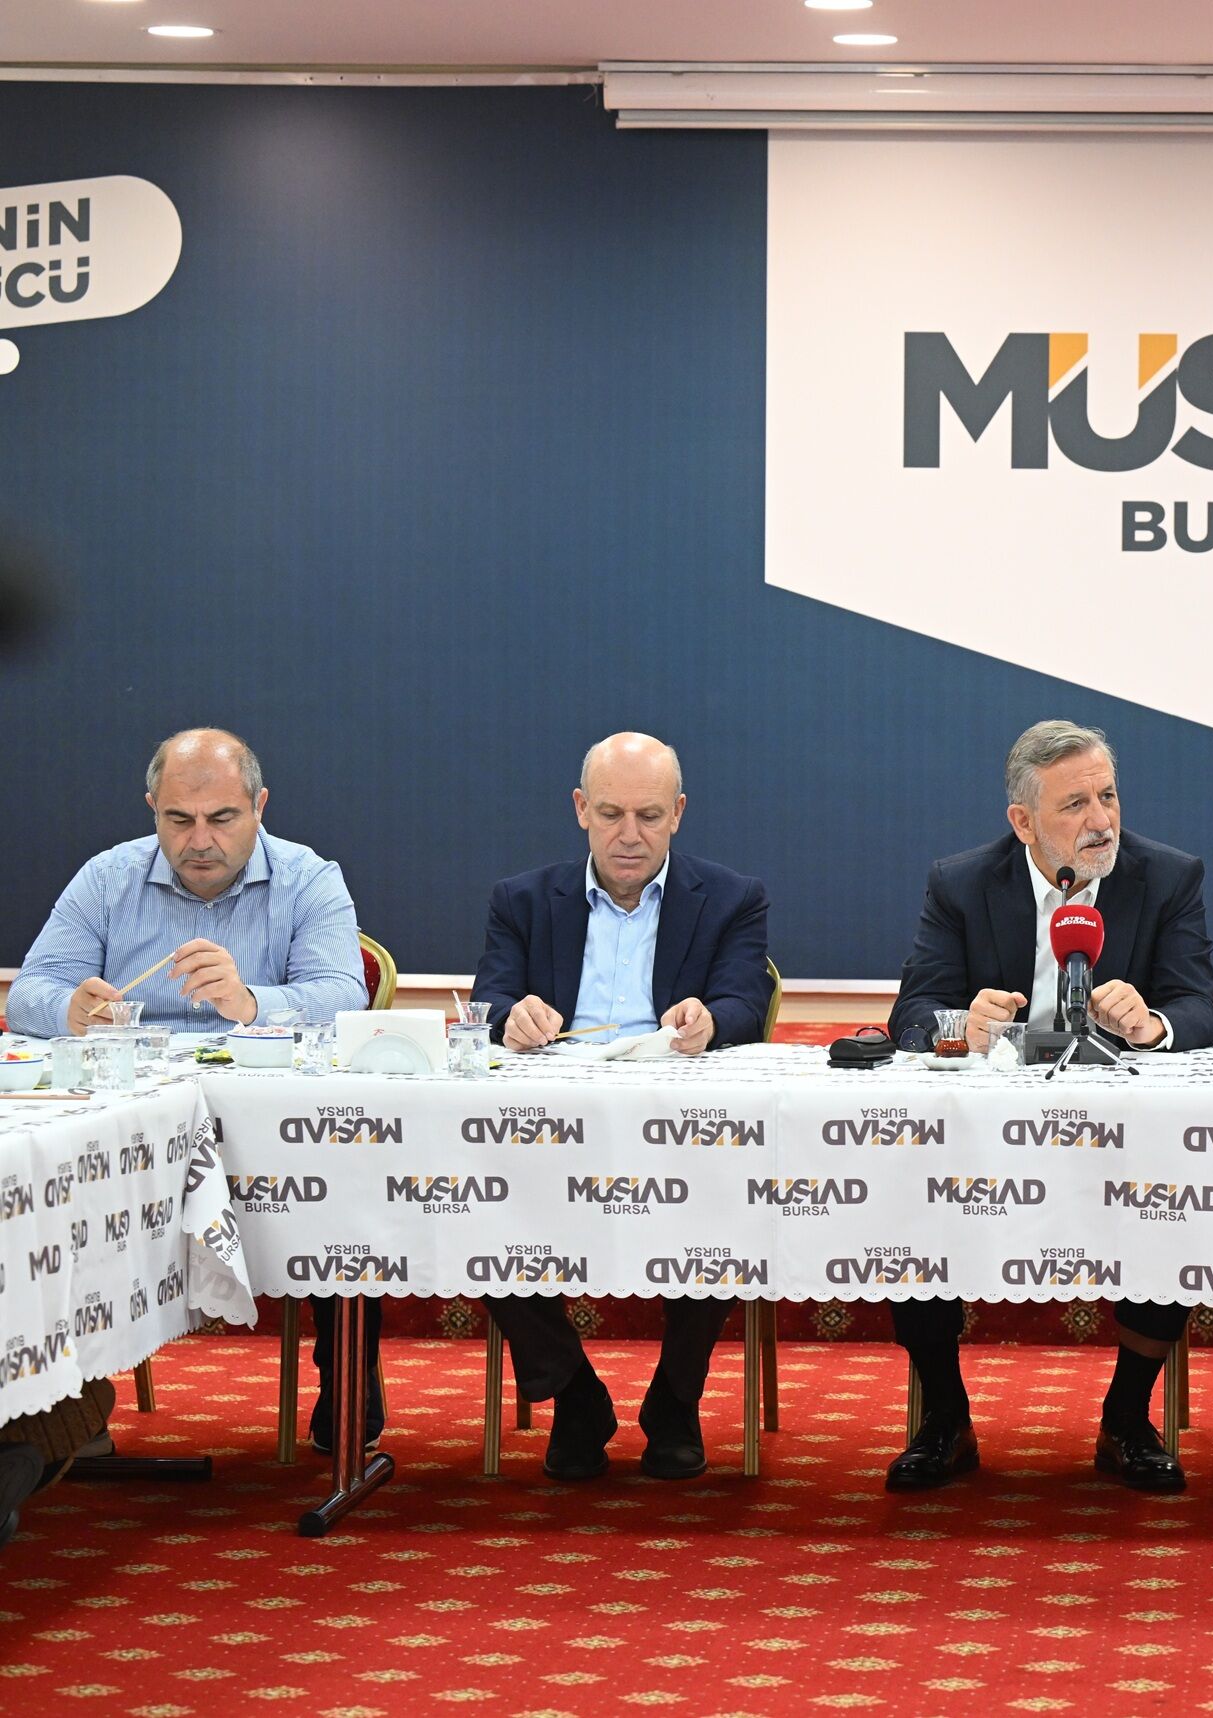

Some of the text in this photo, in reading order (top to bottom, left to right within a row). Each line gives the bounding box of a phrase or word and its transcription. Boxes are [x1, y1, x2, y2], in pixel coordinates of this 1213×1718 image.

[0, 256, 90, 308] CÜ
[317, 1107, 364, 1116] BURSA
[499, 1107, 546, 1117] BURSA
[680, 1109, 727, 1118] BURSA
[861, 1108, 907, 1118] BURSA
[1041, 1109, 1087, 1120] BURSA
[245, 1202, 290, 1213] BURSA
[423, 1204, 470, 1213] BURSA
[603, 1204, 650, 1214] BURSA
[783, 1206, 829, 1216] BURSA
[963, 1205, 1007, 1215] BURSA
[1140, 1210, 1186, 1222] BURSA
[324, 1245, 370, 1254] BURSA
[505, 1245, 551, 1255] BURSA
[684, 1247, 730, 1257] BURSA
[864, 1247, 911, 1257] BURSA
[1040, 1248, 1084, 1258] BURSA
